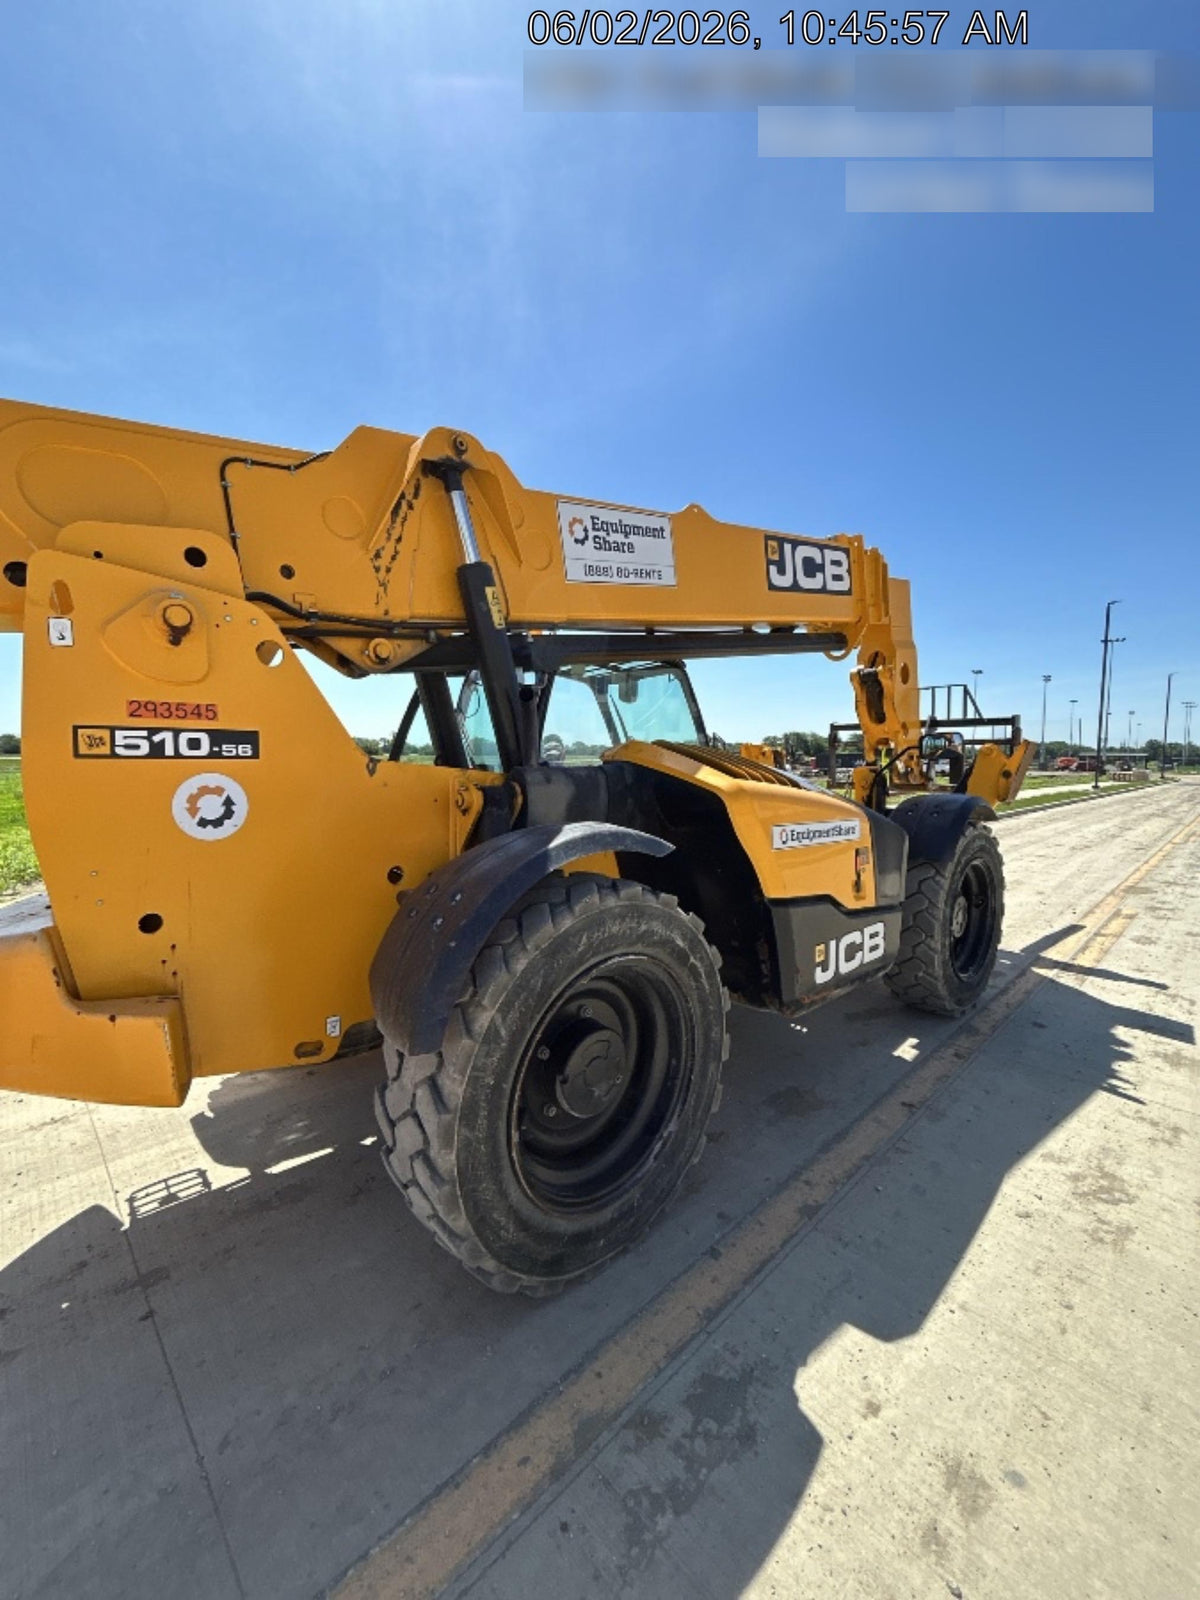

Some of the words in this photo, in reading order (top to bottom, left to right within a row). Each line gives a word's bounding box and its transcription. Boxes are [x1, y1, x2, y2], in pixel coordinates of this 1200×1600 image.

[590, 515, 666, 540] Equipment
[592, 535, 636, 554] Share
[584, 563, 614, 579] (888)
[769, 541, 851, 591] JCB
[128, 700, 218, 721] 293545
[814, 922, 885, 984] JCB
